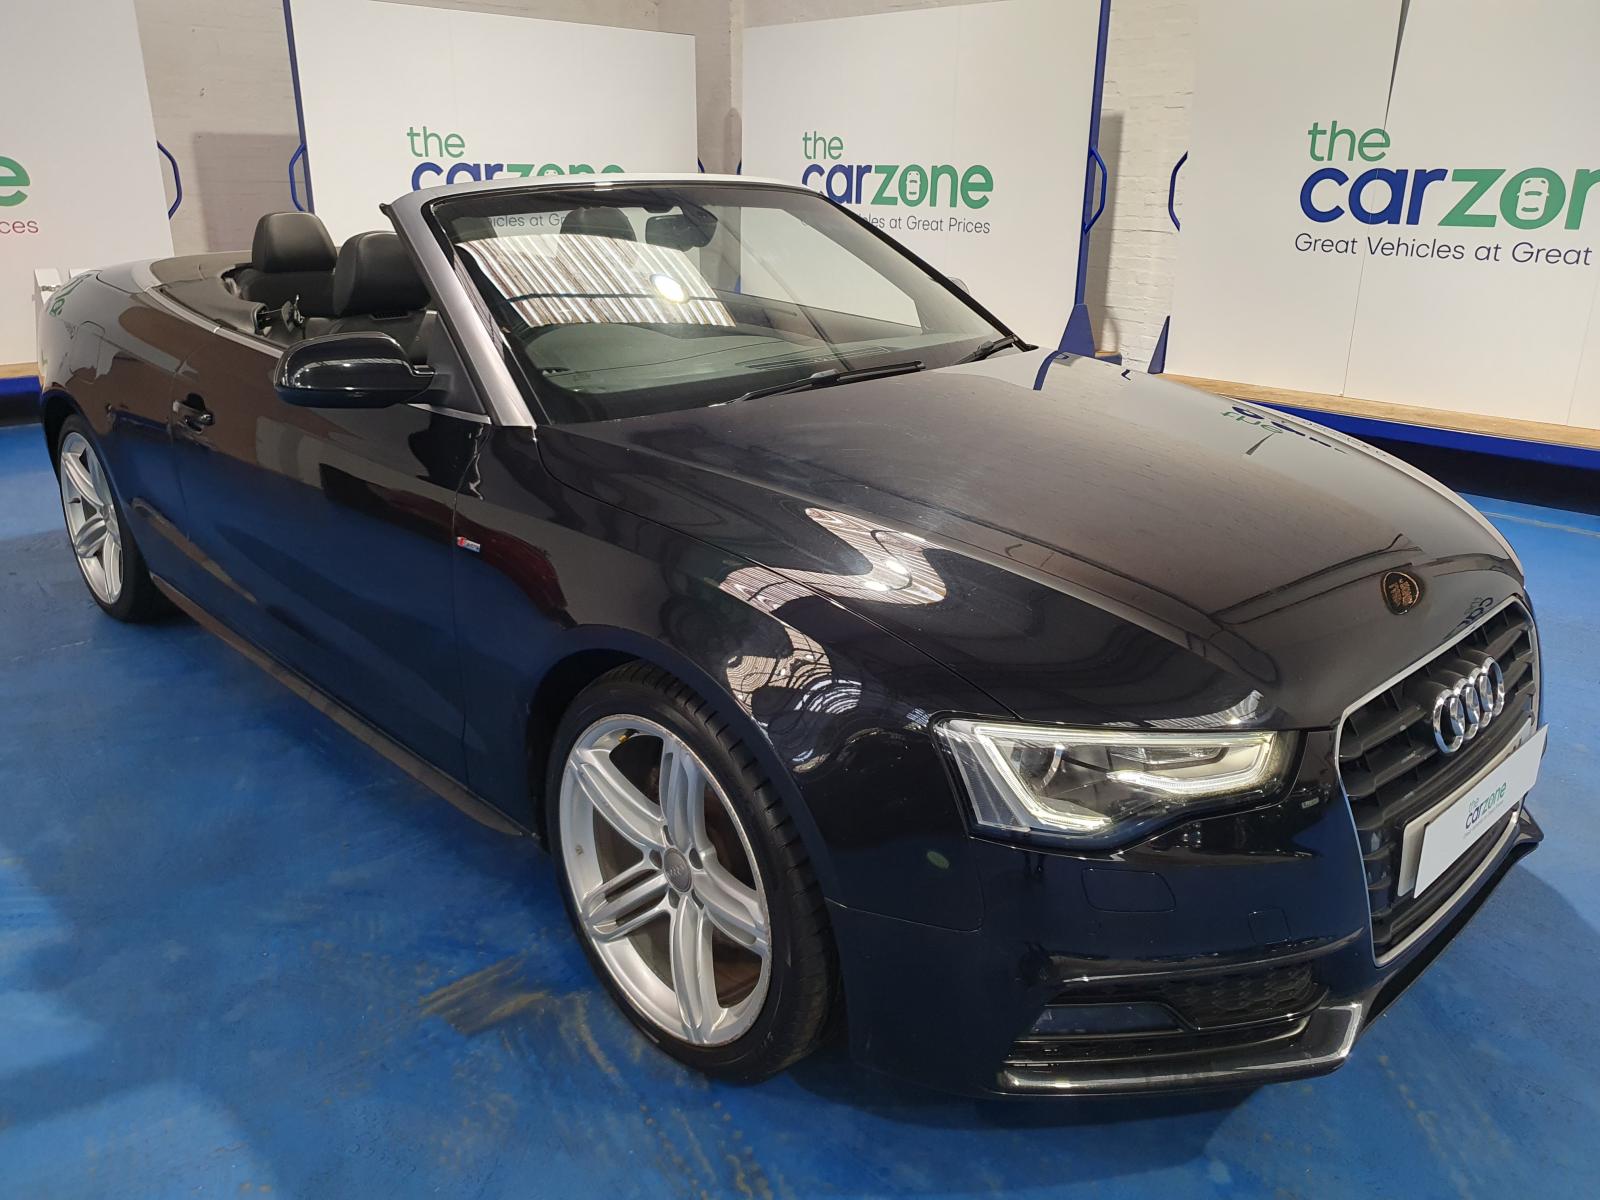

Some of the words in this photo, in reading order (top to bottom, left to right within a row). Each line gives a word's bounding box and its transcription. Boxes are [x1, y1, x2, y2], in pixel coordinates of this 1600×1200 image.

[407, 126, 466, 158] the
[802, 131, 844, 160] the
[1308, 120, 1391, 162] the
[0, 220, 39, 234] ces
[529, 215, 544, 227] at
[889, 215, 902, 230] at
[906, 215, 944, 232] Great
[949, 217, 991, 234] Prices
[1295, 232, 1358, 255] Great
[1367, 236, 1466, 261] Vehicles
[1474, 242, 1502, 262] at
[1511, 242, 1593, 266] Great
[1465, 782, 1507, 829] carzone
